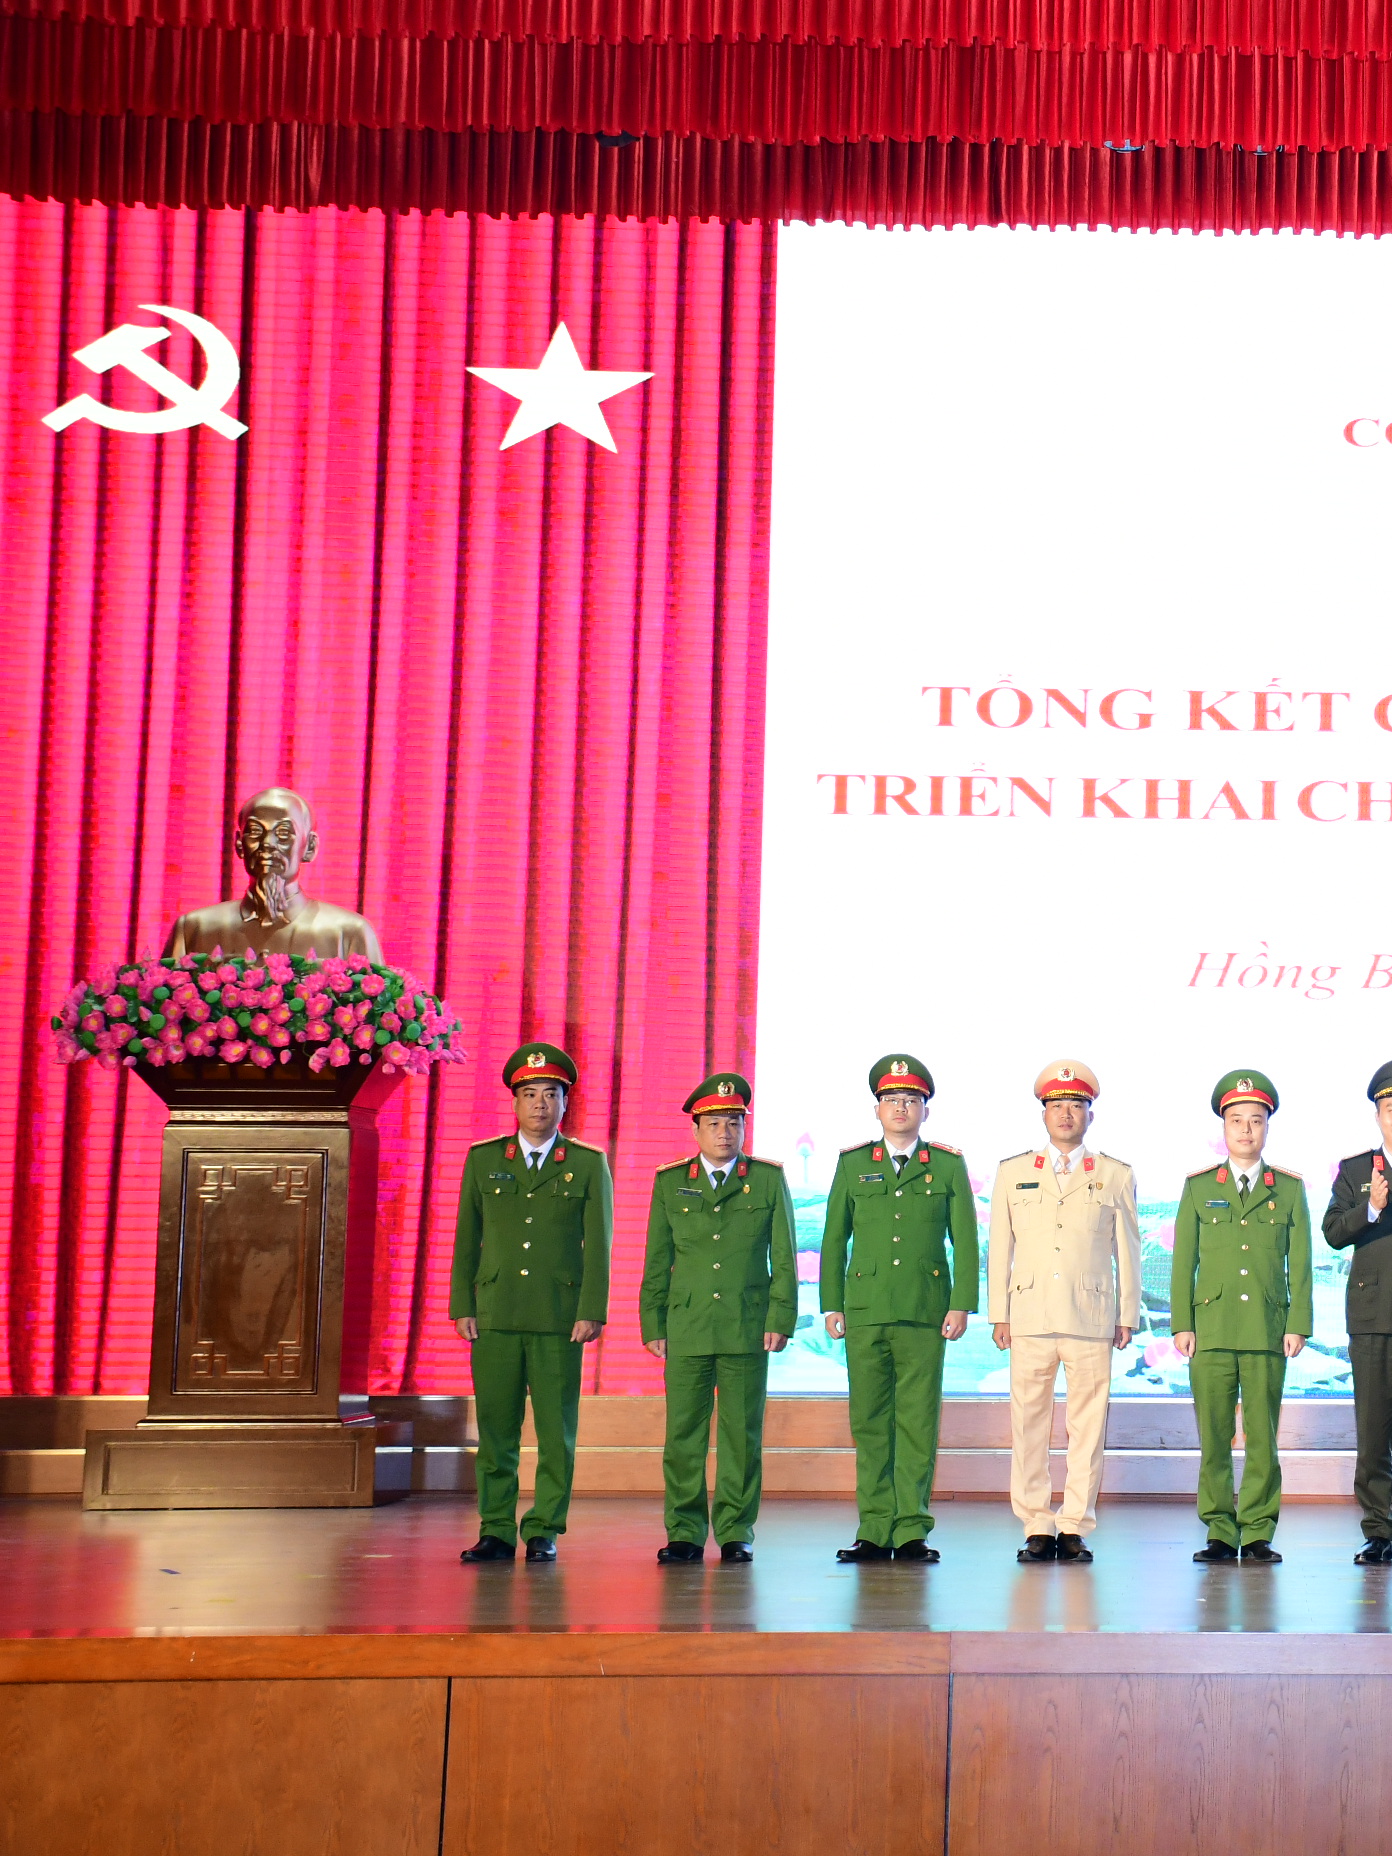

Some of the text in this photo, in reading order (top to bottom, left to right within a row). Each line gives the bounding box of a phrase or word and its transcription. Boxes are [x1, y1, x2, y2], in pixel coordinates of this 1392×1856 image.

[922, 674, 1155, 730] TỔNG
[1187, 678, 1350, 732] KẾT
[817, 763, 1055, 817] TRIỂN
[1080, 778, 1278, 820] KHAI
[1188, 941, 1341, 999] Hồng
